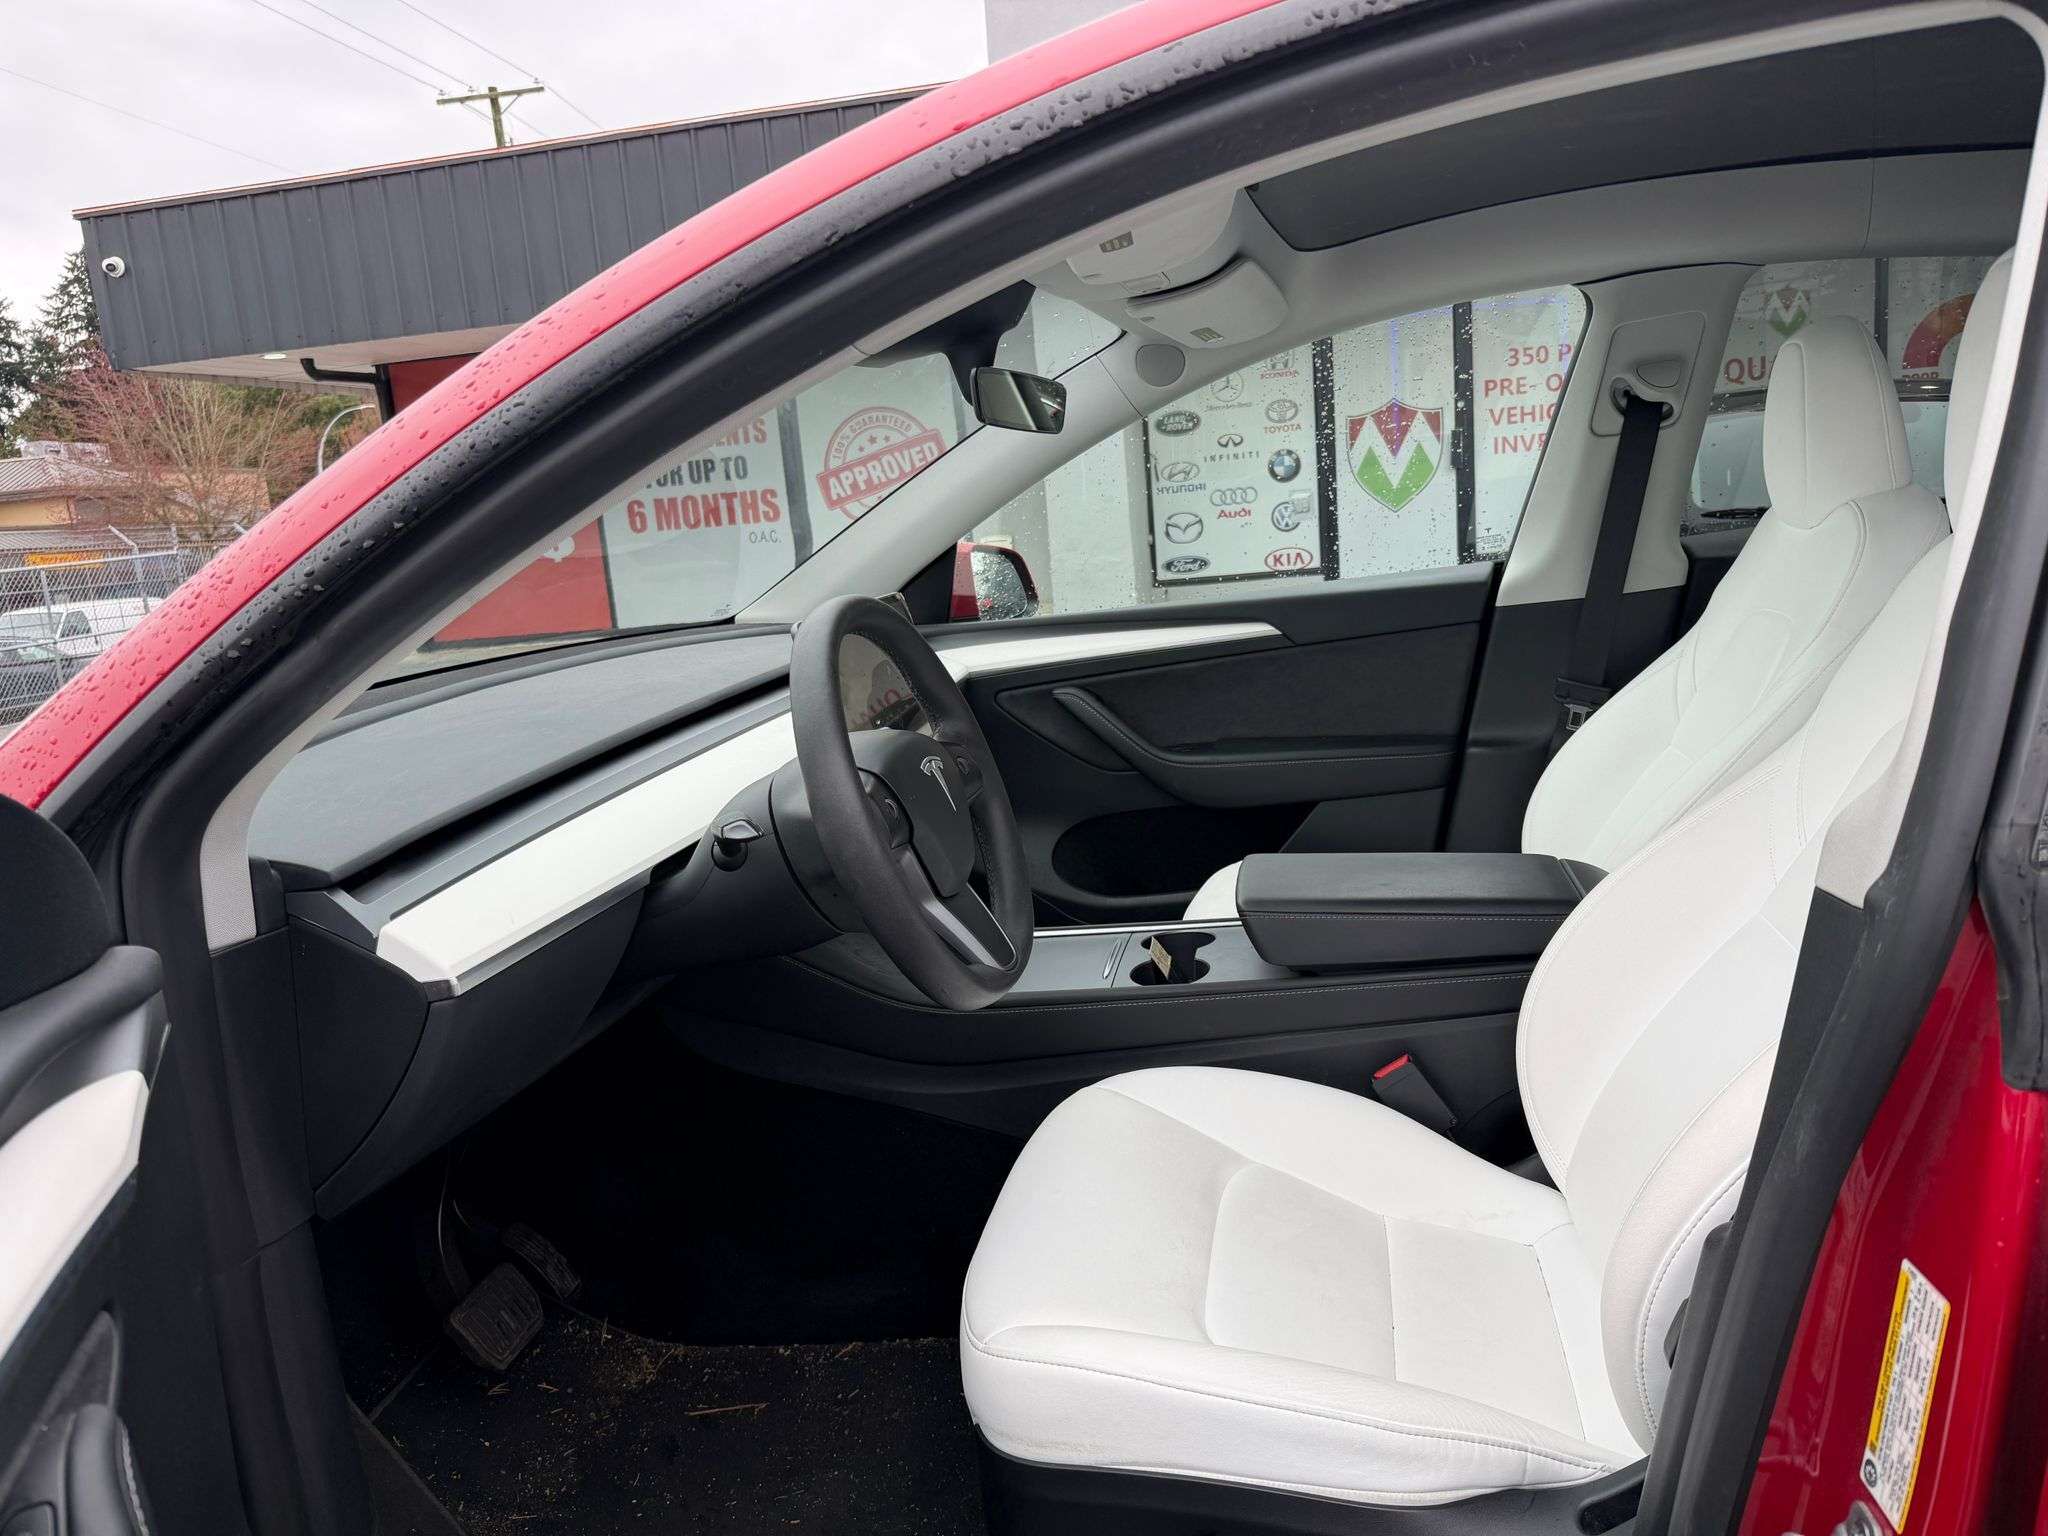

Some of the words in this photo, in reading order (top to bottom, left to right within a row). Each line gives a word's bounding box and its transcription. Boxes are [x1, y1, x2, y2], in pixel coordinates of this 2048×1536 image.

[1507, 345, 1549, 367] 350
[849, 414, 913, 433] GUARANTEED
[1264, 424, 1302, 433] TOYOTA
[1204, 451, 1260, 462] INFINITI
[688, 459, 716, 485] UP
[721, 455, 749, 481] TO
[829, 441, 939, 501] APPROVED
[1157, 484, 1206, 494] HYUNDAI
[627, 499, 648, 534] 6
[654, 488, 781, 531] MONTHS
[1217, 508, 1251, 519] Audi
[749, 530, 782, 543] O.A.C.
[1273, 553, 1305, 567] KIA
